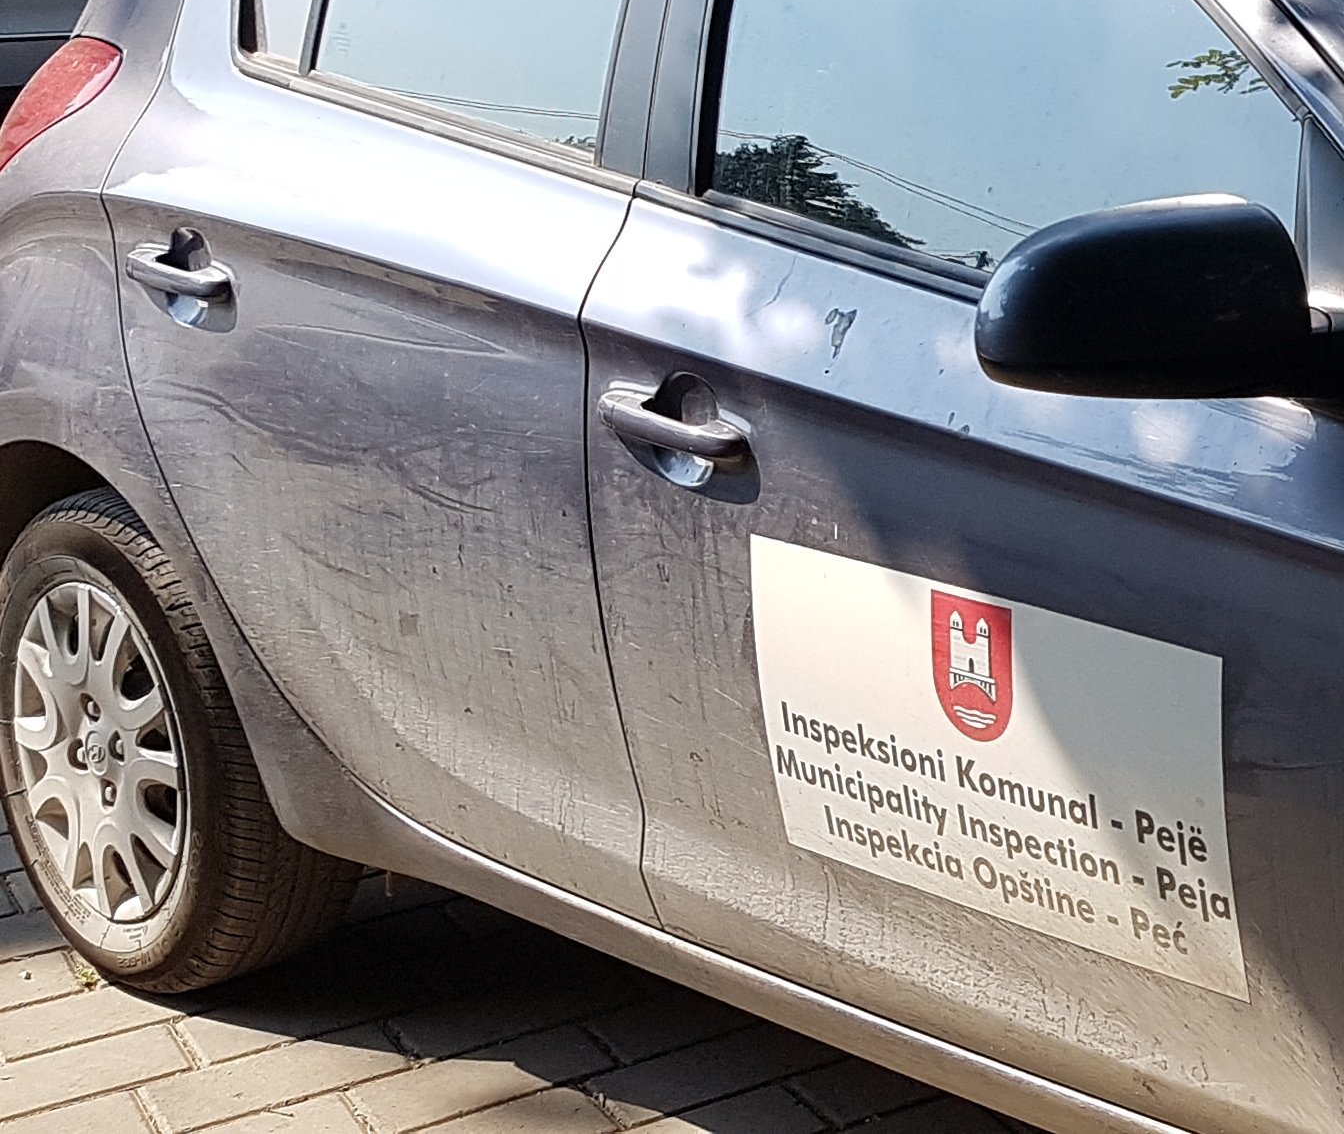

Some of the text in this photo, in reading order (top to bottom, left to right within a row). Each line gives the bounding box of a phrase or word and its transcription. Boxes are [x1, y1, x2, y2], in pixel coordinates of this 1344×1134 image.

[775, 744, 948, 837] Municipality
[956, 803, 1121, 886] Inspection
[1155, 865, 1232, 923] Peja
[780, 700, 947, 783] Inspeksioni
[955, 754, 1099, 830] Komunal
[1134, 808, 1208, 867] Pejë
[823, 804, 965, 881] Inspekcia
[972, 856, 1096, 924] Opštine
[1129, 906, 1189, 956] Peć
